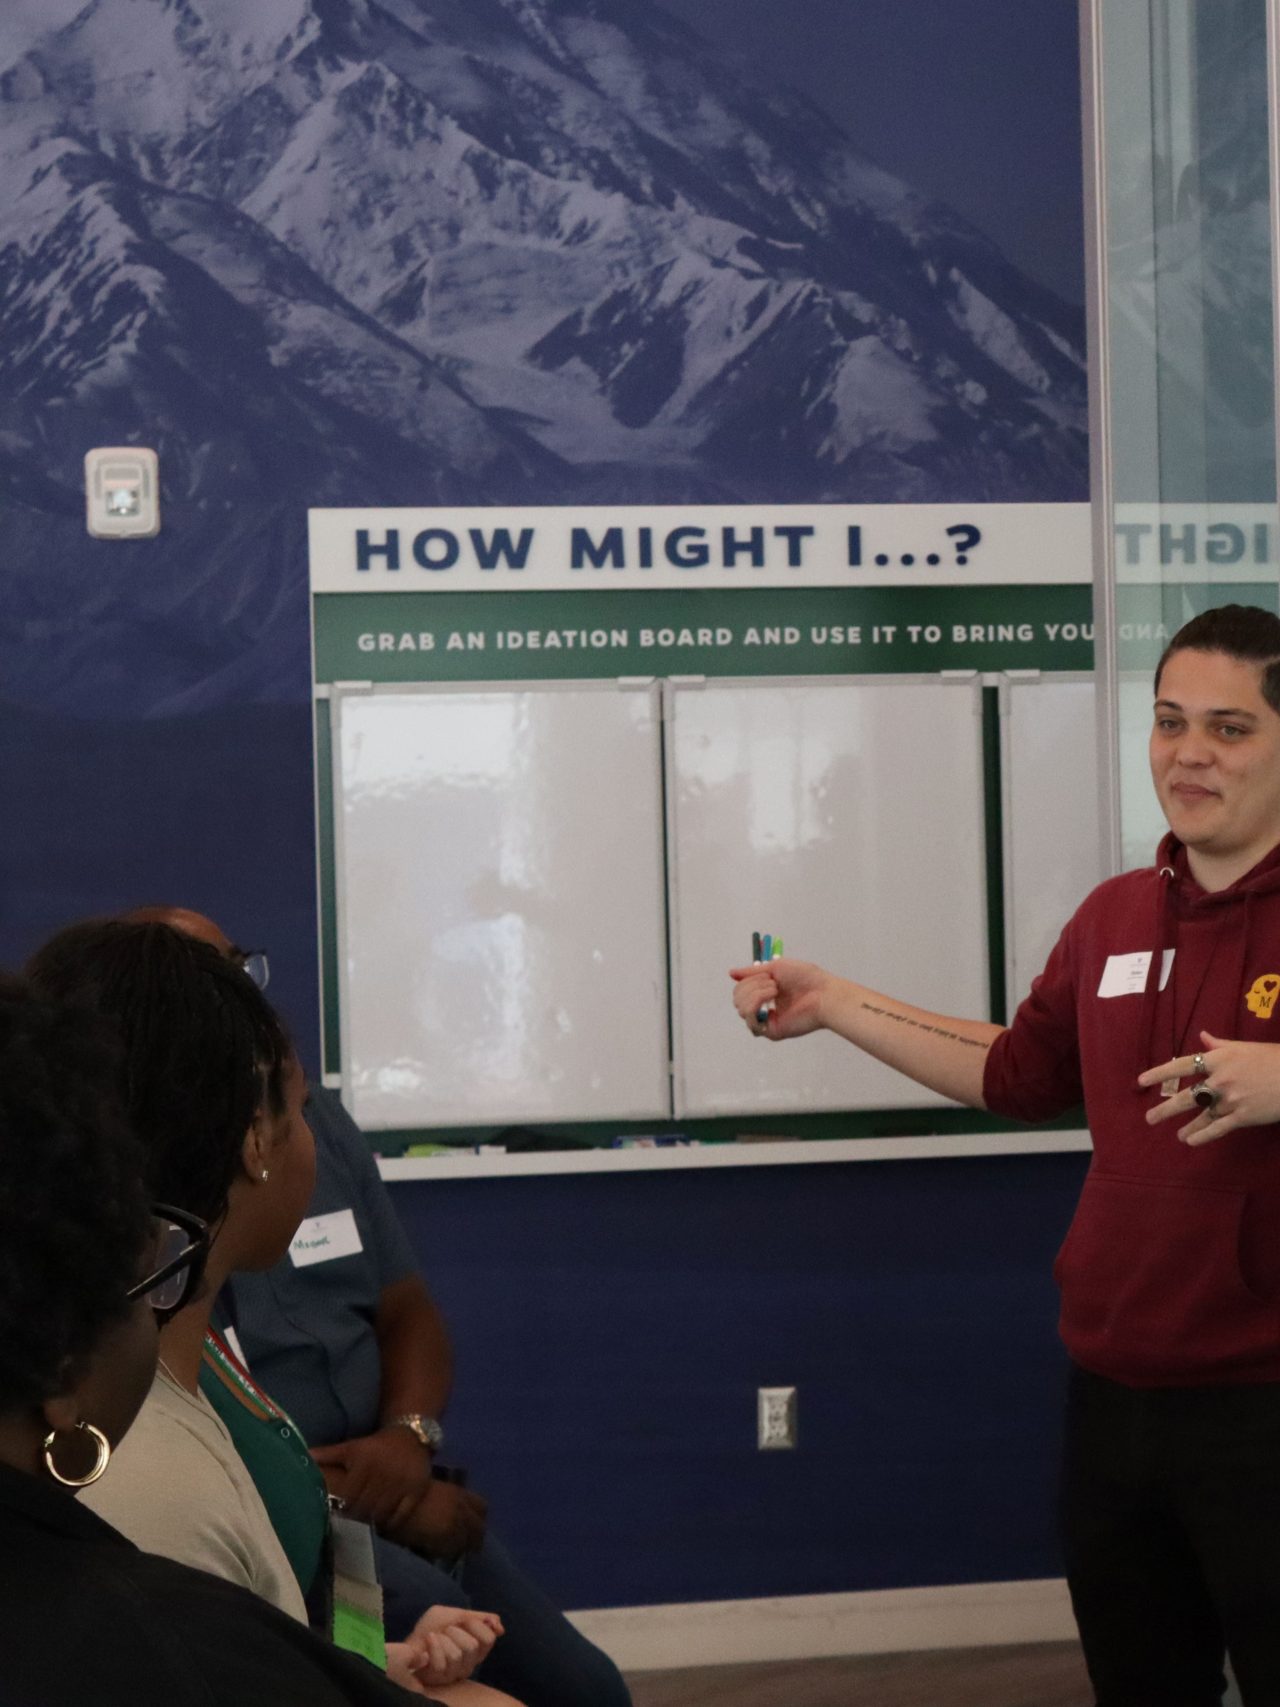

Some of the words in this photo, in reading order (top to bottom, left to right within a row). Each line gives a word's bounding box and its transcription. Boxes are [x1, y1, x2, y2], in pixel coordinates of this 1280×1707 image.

[356, 527, 534, 571] HOW
[570, 525, 815, 569] MIGHT
[847, 523, 982, 567] I...?
[358, 633, 435, 651] GRAB
[446, 632, 485, 650] AN
[497, 630, 628, 648] IDEATION
[640, 628, 732, 647] BOARD
[744, 627, 800, 645] AND
[811, 627, 861, 644] USE
[873, 626, 897, 643] IT
[907, 626, 941, 643] TO
[952, 624, 1033, 642] BRING
